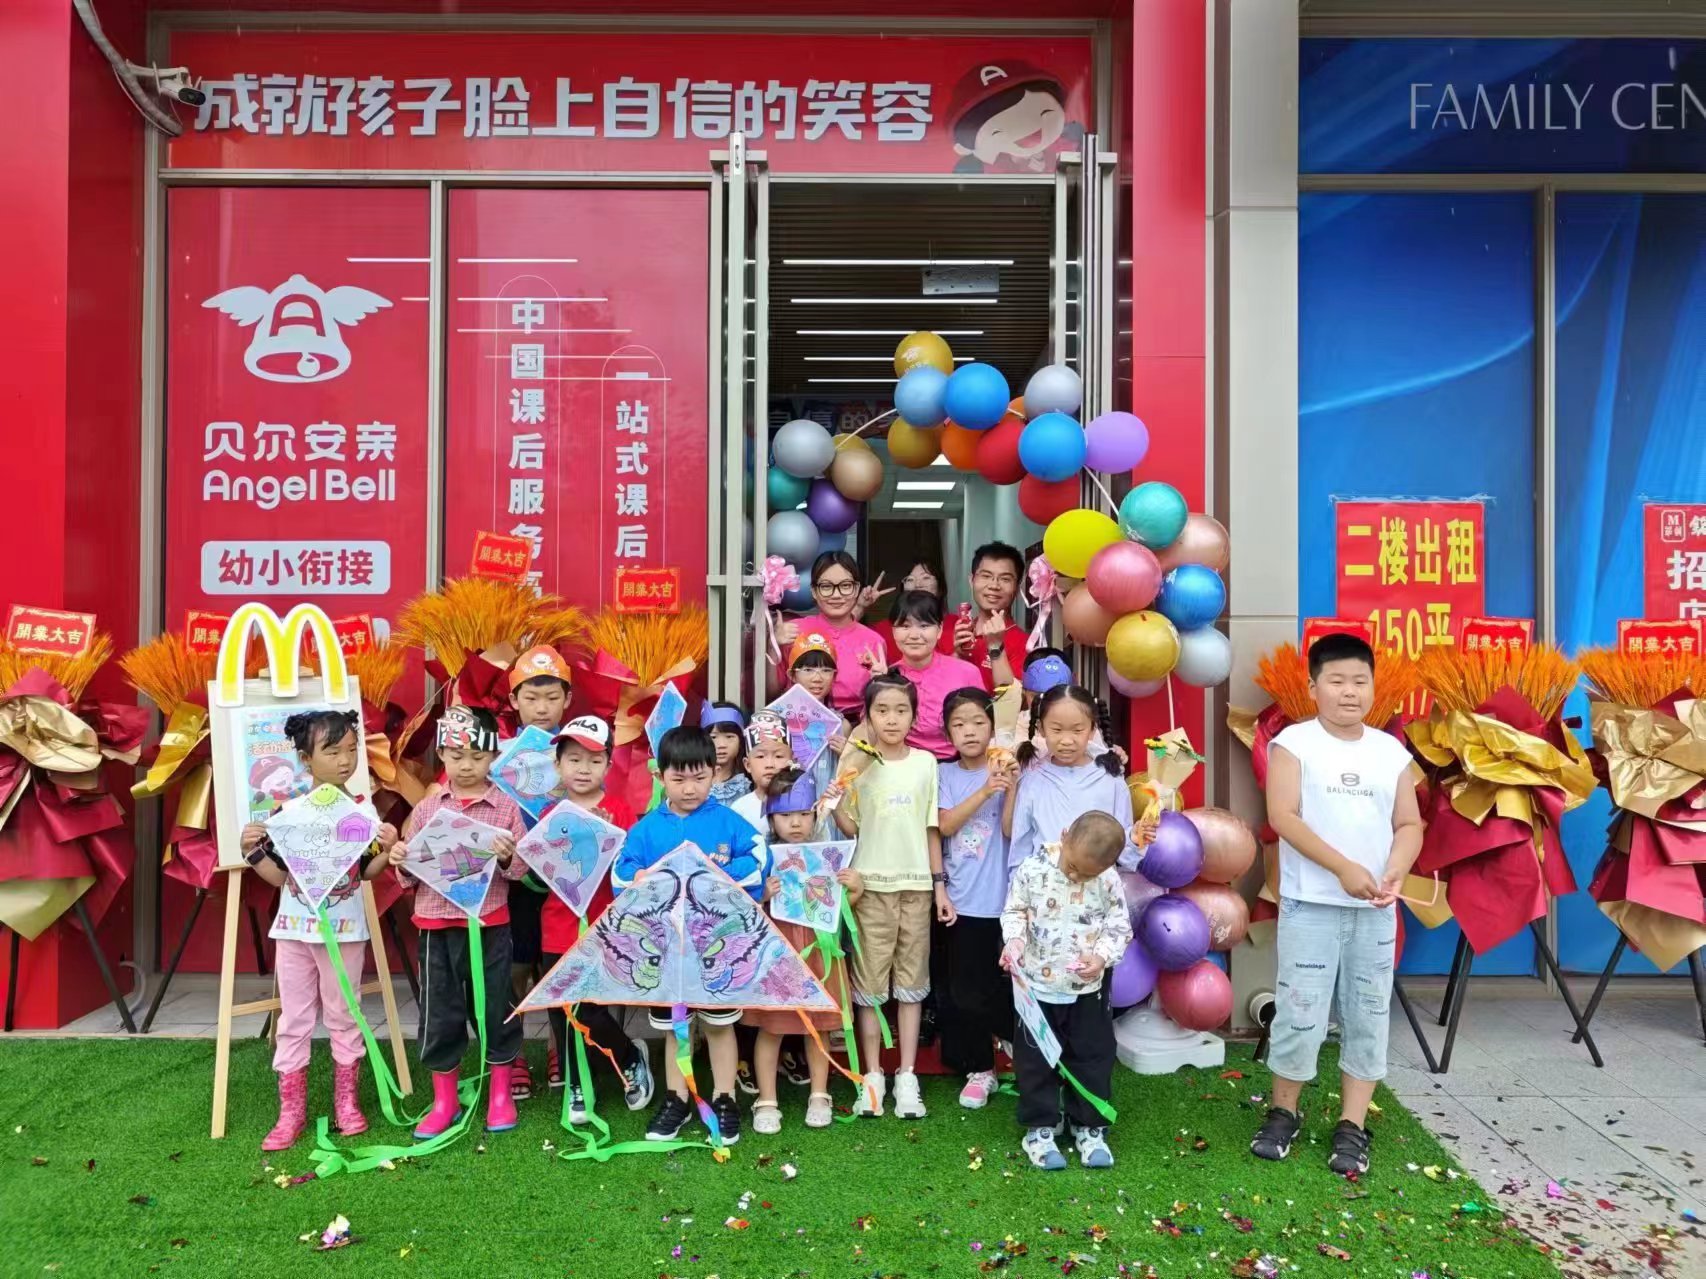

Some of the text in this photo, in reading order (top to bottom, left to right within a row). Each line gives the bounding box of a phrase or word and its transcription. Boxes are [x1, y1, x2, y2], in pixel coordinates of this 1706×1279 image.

[194, 73, 933, 141] 成就孩子脸上自信的笑容
[1410, 82, 1595, 130] FAMILY
[203, 420, 397, 462] 贝尔安亲
[203, 469, 396, 510] Angel Bell
[615, 371, 649, 569] 一站式课后
[218, 548, 375, 586] 幼小衔接
[1344, 515, 1477, 586] 二楼出租
